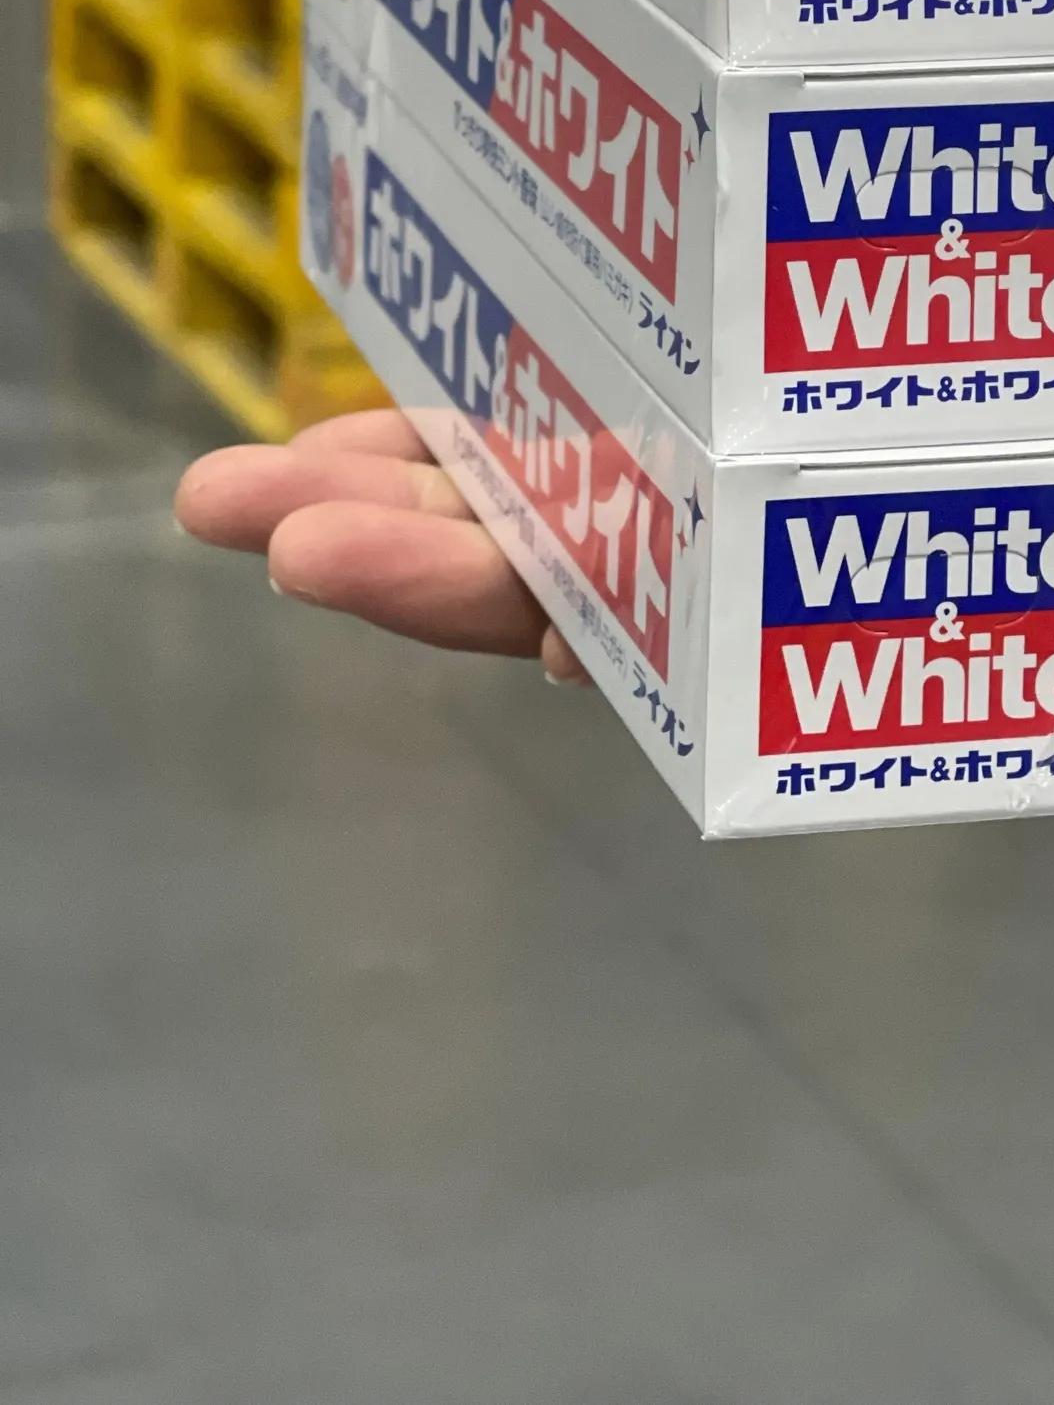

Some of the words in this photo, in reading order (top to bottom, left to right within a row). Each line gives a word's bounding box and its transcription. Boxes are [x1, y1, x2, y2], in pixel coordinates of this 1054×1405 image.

[934, 218, 971, 261] &
[638, 291, 701, 375] ライオン
[929, 601, 966, 643] &
[633, 661, 694, 757] ライオン
